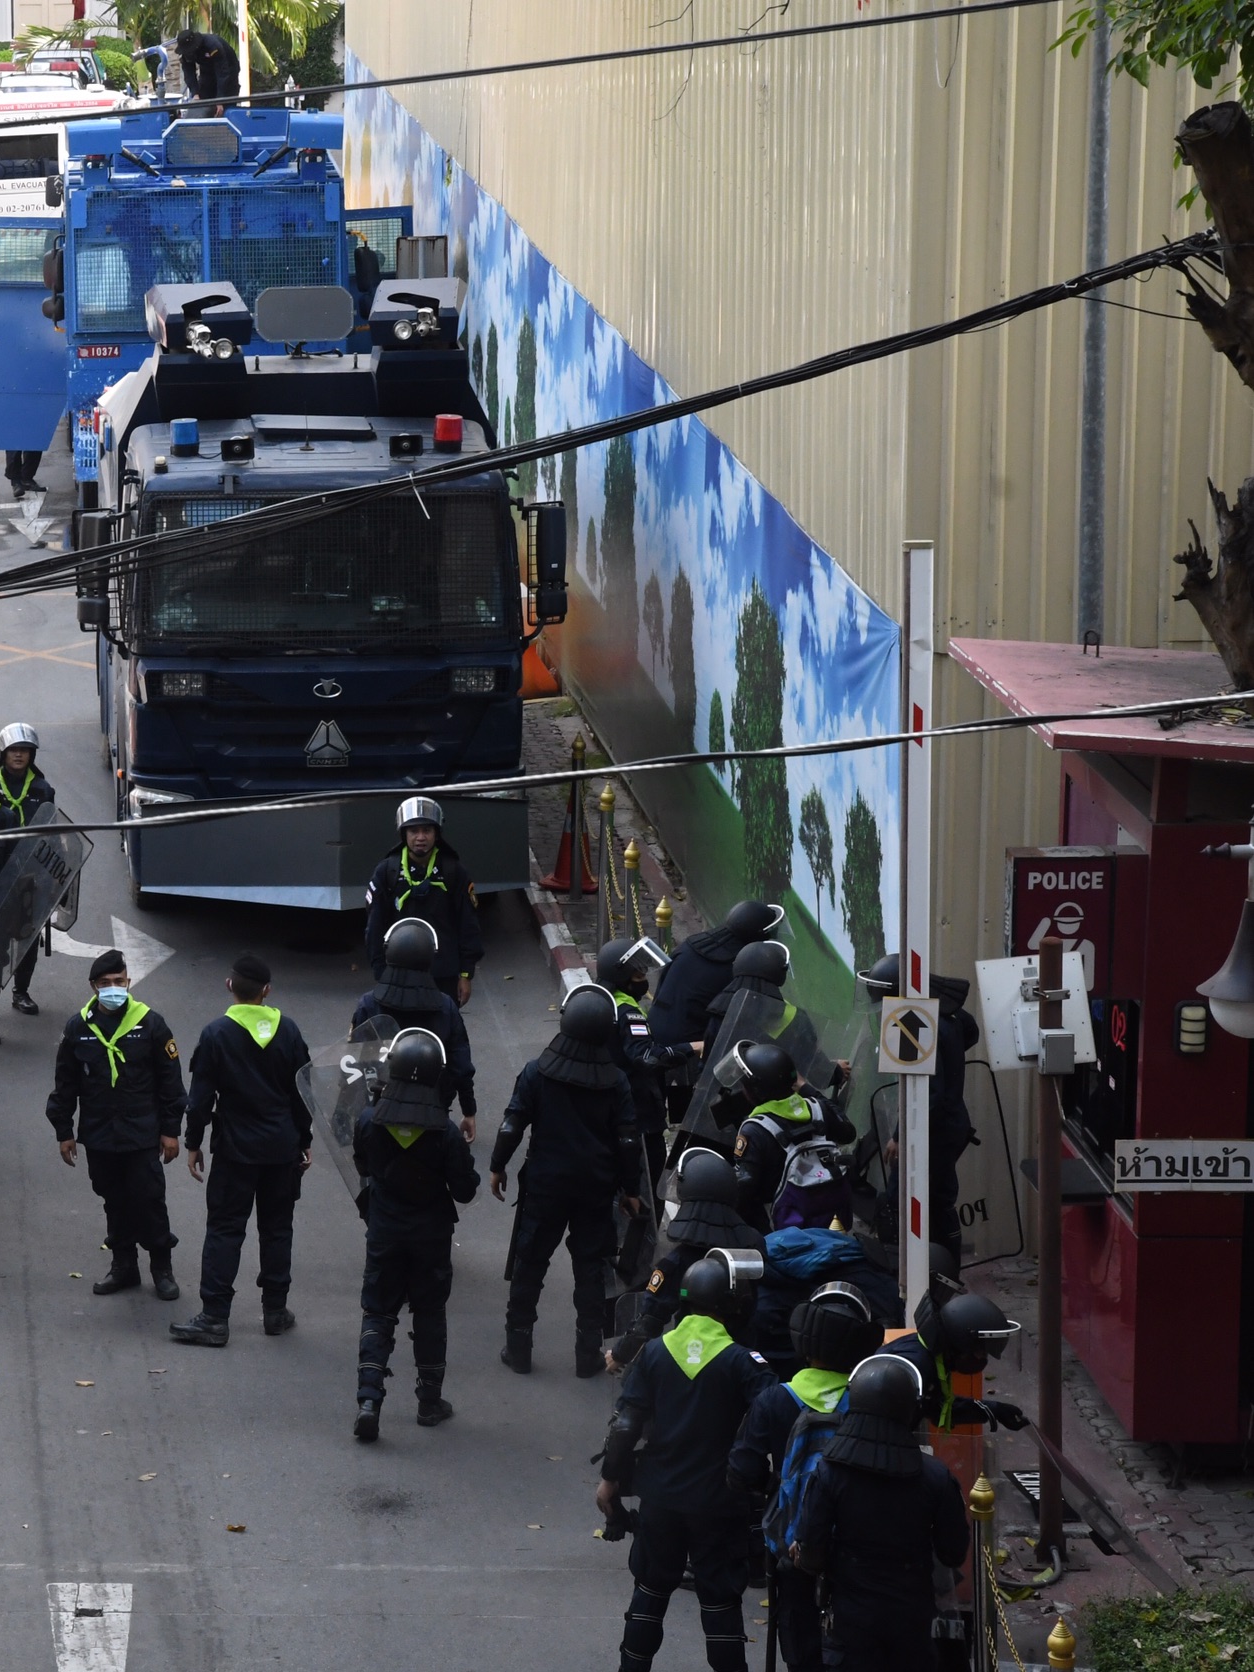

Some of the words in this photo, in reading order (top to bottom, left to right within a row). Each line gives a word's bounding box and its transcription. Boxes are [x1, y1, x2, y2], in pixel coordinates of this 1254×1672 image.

[11, 181, 47, 190] EVACUAT
[91, 346, 119, 357] 10374
[33, 838, 73, 887] POLICE
[1027, 871, 1105, 891] POLICE
[1117, 1146, 1251, 1178] ห้ามเข้า
